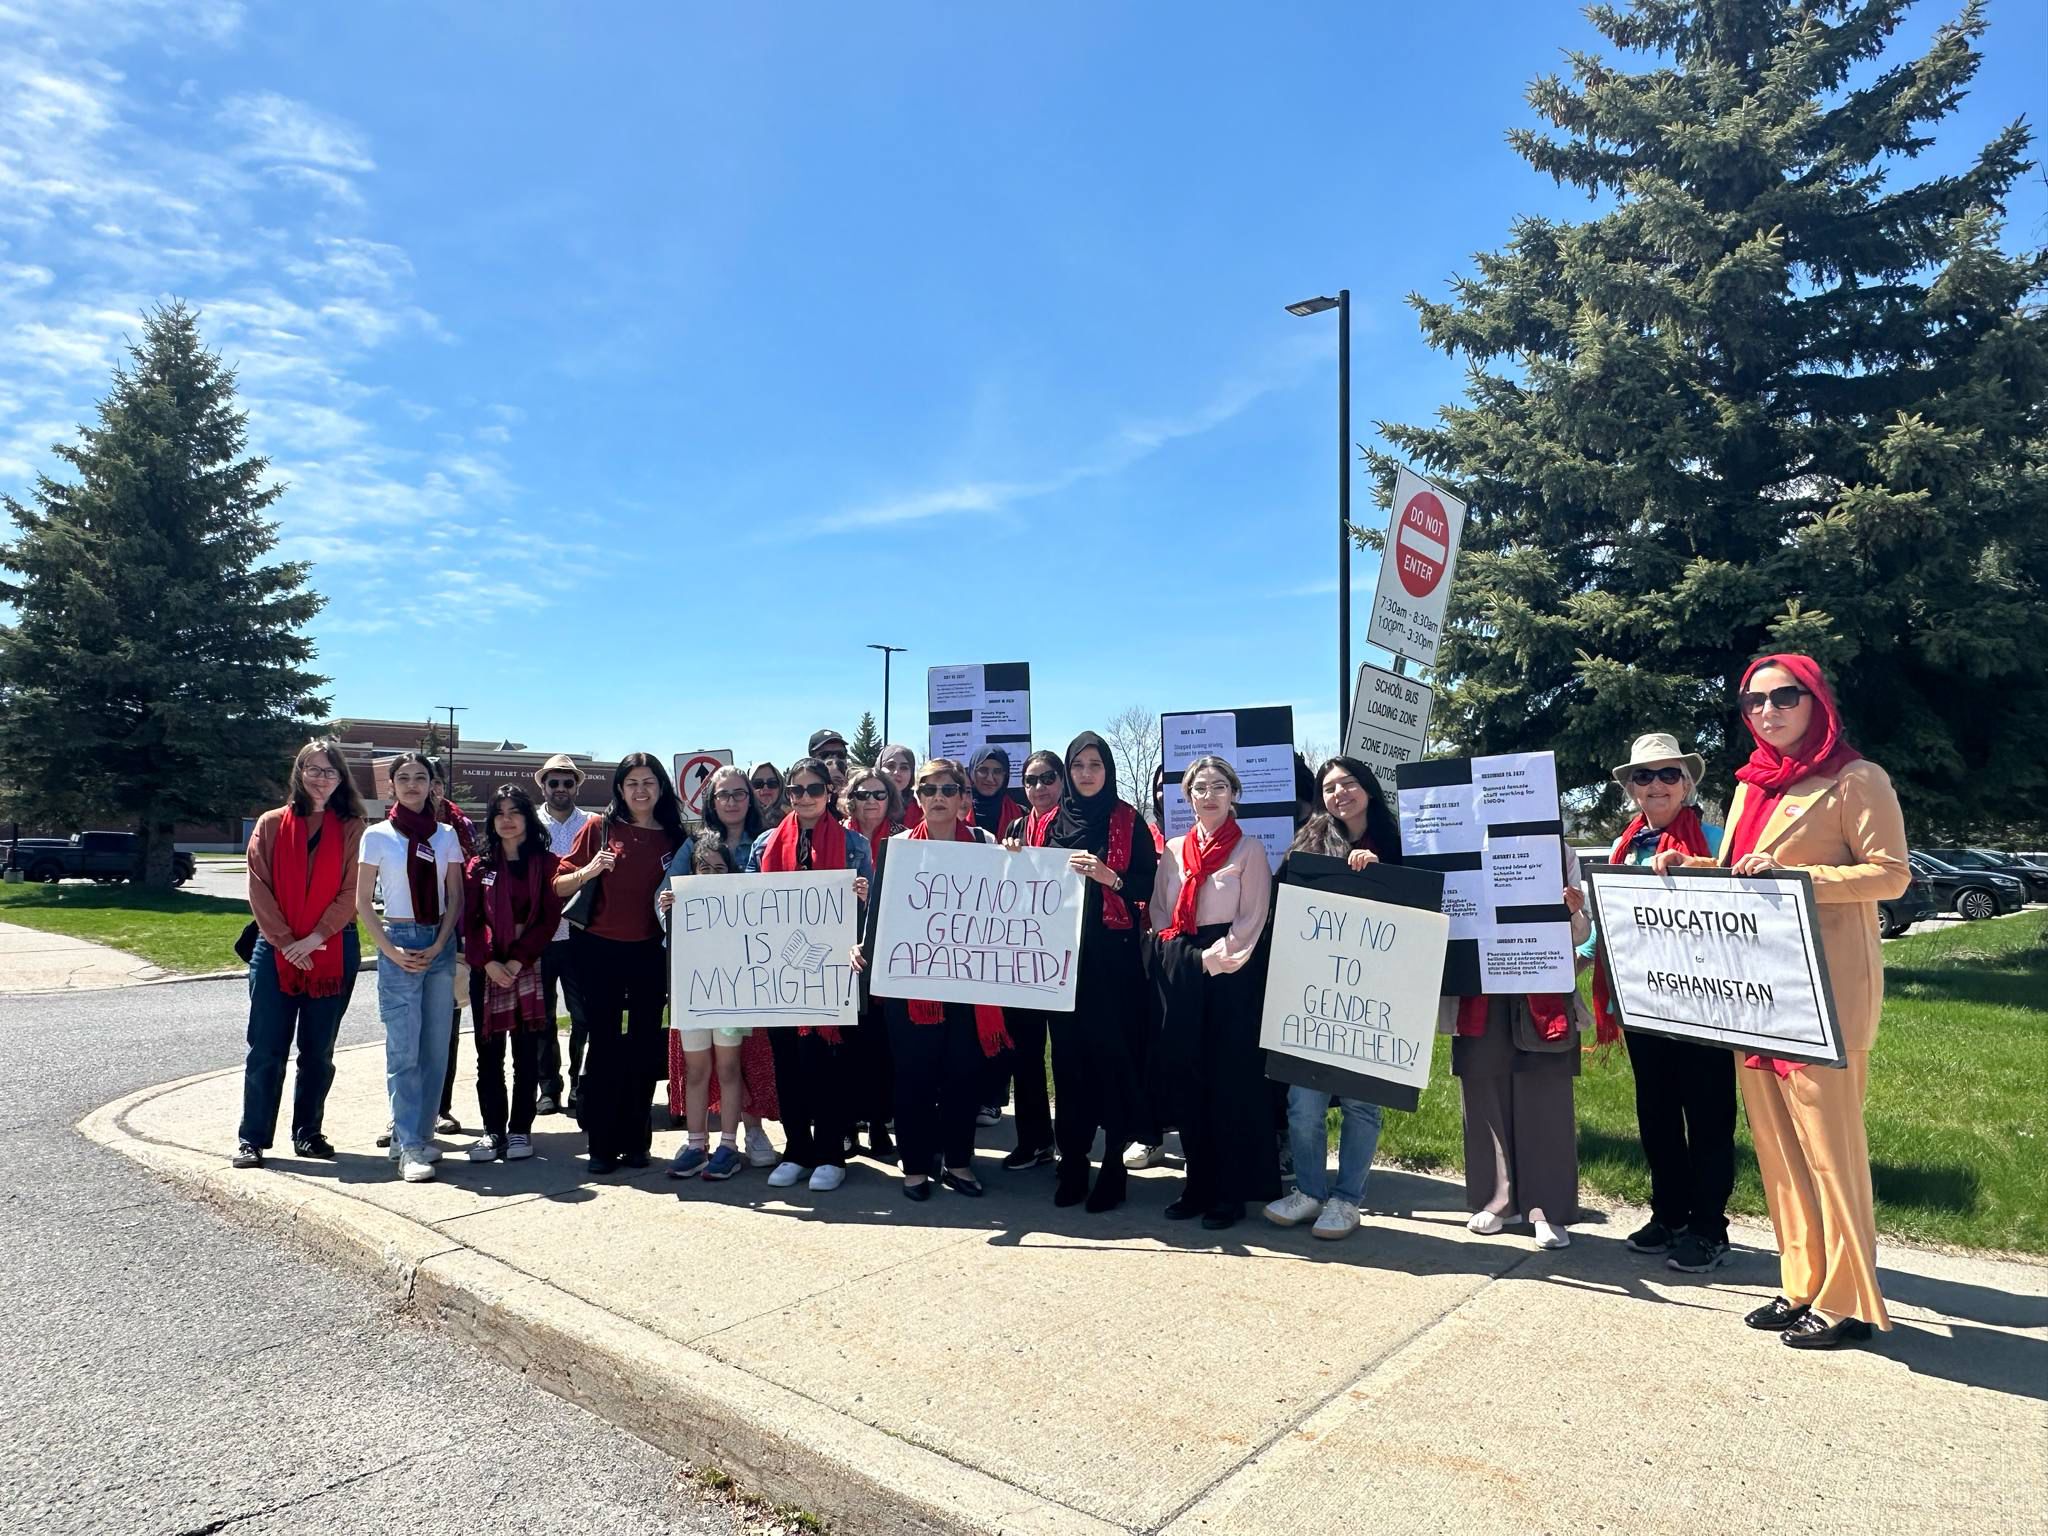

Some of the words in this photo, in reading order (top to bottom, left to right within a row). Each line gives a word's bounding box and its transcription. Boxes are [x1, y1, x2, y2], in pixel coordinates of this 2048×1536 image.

[1410, 506, 1424, 526] DO
[1426, 514, 1444, 537] NOT
[1404, 554, 1434, 582] ENTER
[1380, 596, 1408, 618] 7:30am
[1412, 610, 1439, 634] 8:30am
[1407, 628, 1434, 650] 3:30pm
[1374, 678, 1403, 700] SCHOOL
[1404, 688, 1420, 705] BUS
[1368, 700, 1398, 721] LOADING
[1400, 710, 1418, 727] ZONE
[1361, 736, 1382, 754] ZONE
[1382, 742, 1412, 762] D'ARRET
[1374, 764, 1397, 782] AUTOB
[685, 886, 844, 932] EDUCATION
[908, 872, 972, 910] SAY
[976, 877, 1018, 914] NO
[1026, 879, 1062, 916] TO
[926, 912, 1044, 946] GENDER
[1300, 906, 1348, 942] SAY
[1360, 917, 1396, 952] NO
[1633, 906, 1758, 934] EDUCATION
[744, 932, 772, 965] IS
[888, 942, 1072, 986] APARTHEID!
[1695, 955, 1705, 964] for
[690, 966, 742, 1007] MY
[748, 964, 854, 1007] RIGHT!
[1328, 954, 1361, 986] TO
[1646, 970, 1774, 1002] AFGHANISTAN
[1304, 984, 1391, 1030] GENDER
[1282, 1014, 1420, 1067] APARTHEID!
